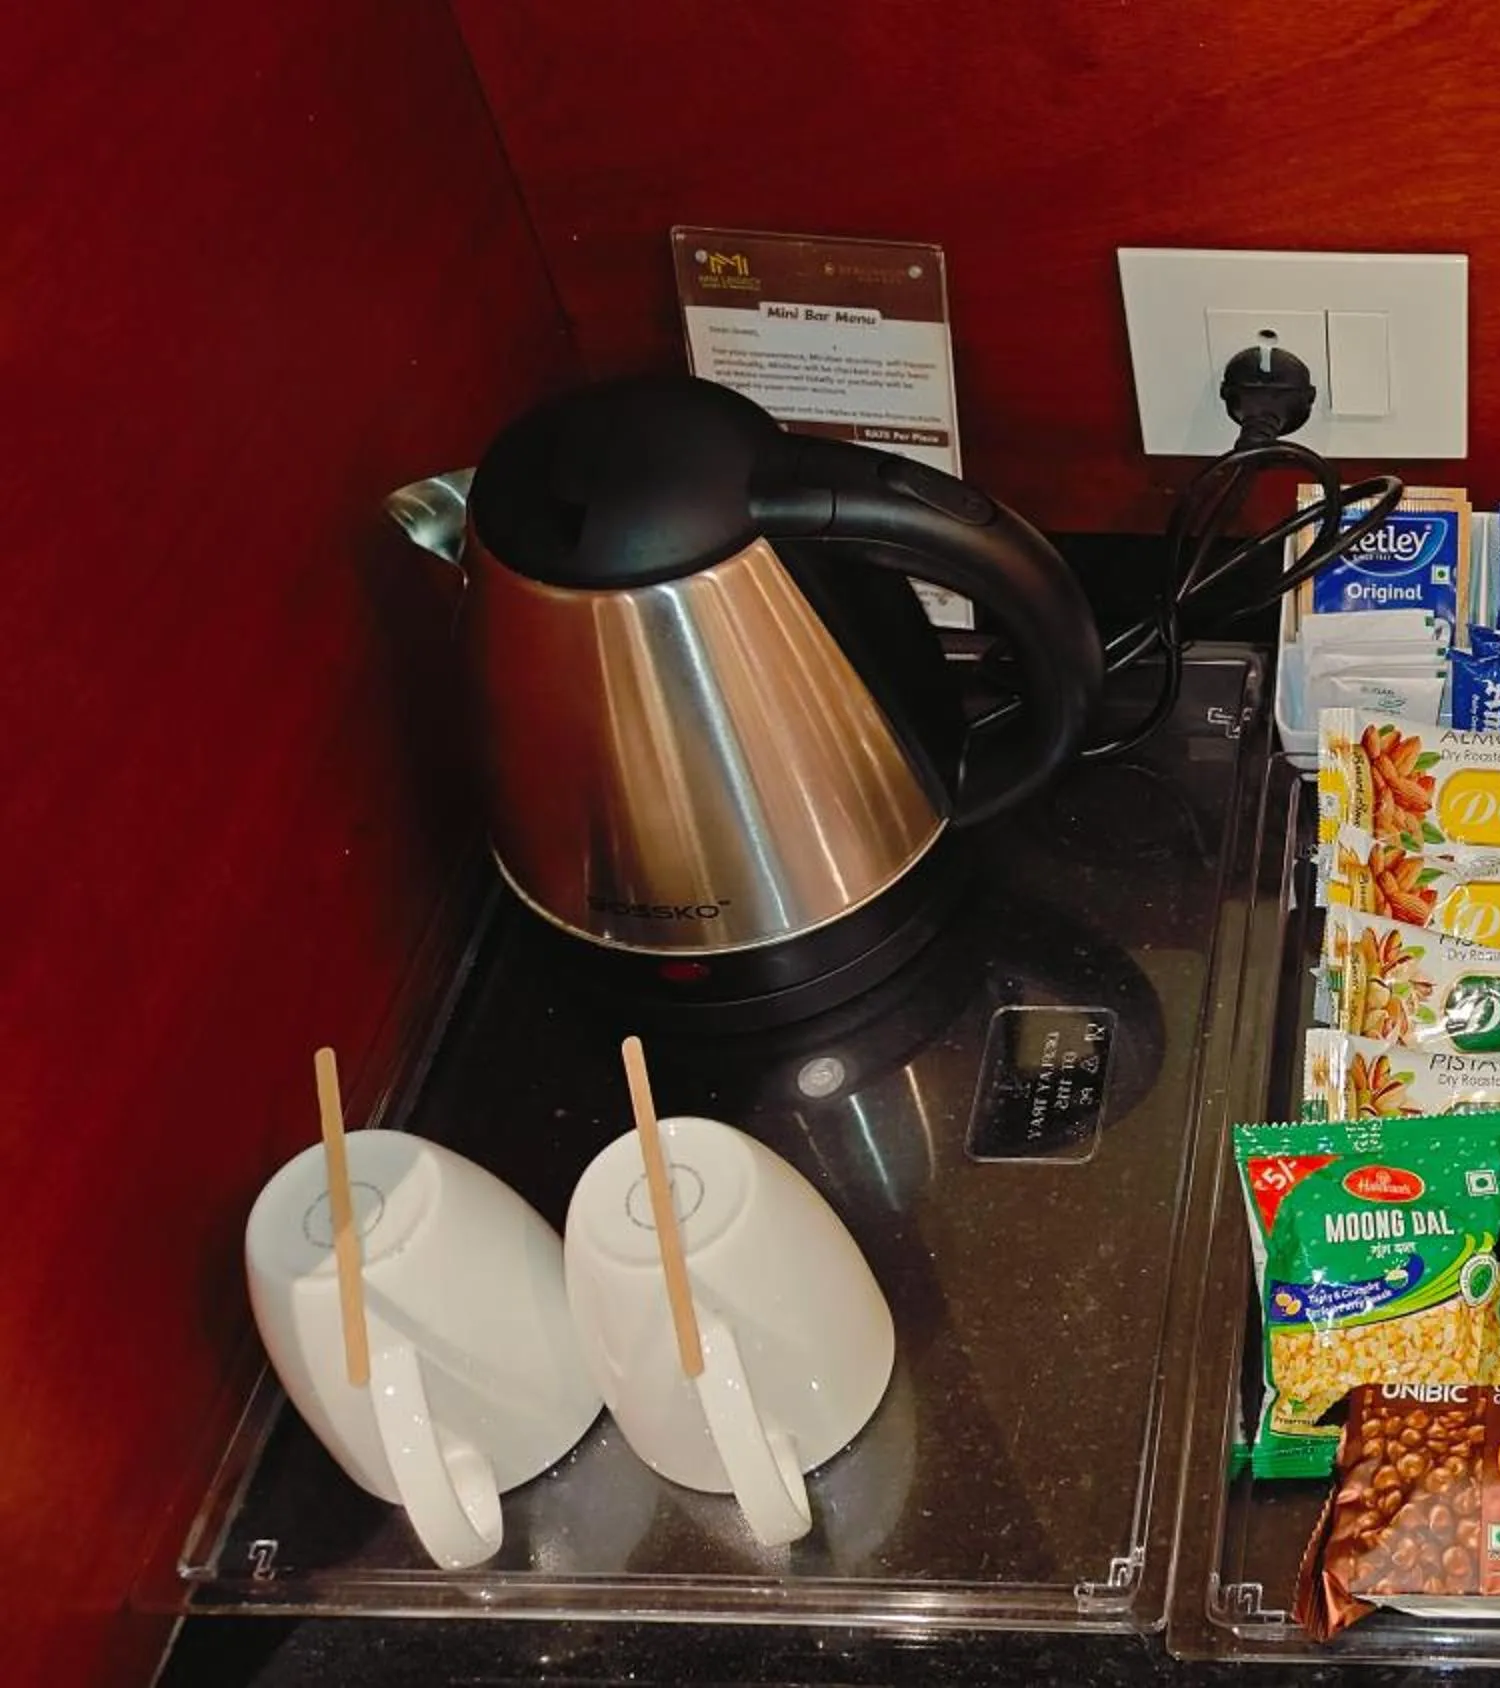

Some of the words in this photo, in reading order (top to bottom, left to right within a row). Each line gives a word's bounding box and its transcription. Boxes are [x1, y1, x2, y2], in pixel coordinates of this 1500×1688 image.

[767, 306, 799, 319] Mini
[805, 309, 829, 321] Bar
[835, 311, 876, 325] Menu
[1347, 582, 1423, 604] Original
[1440, 750, 1460, 764] Dry
[1438, 1074, 1460, 1088] Dry
[1325, 1210, 1405, 1243] MOONG
[1411, 1209, 1455, 1236] DAL
[1381, 1382, 1469, 1403] UNIBIC
